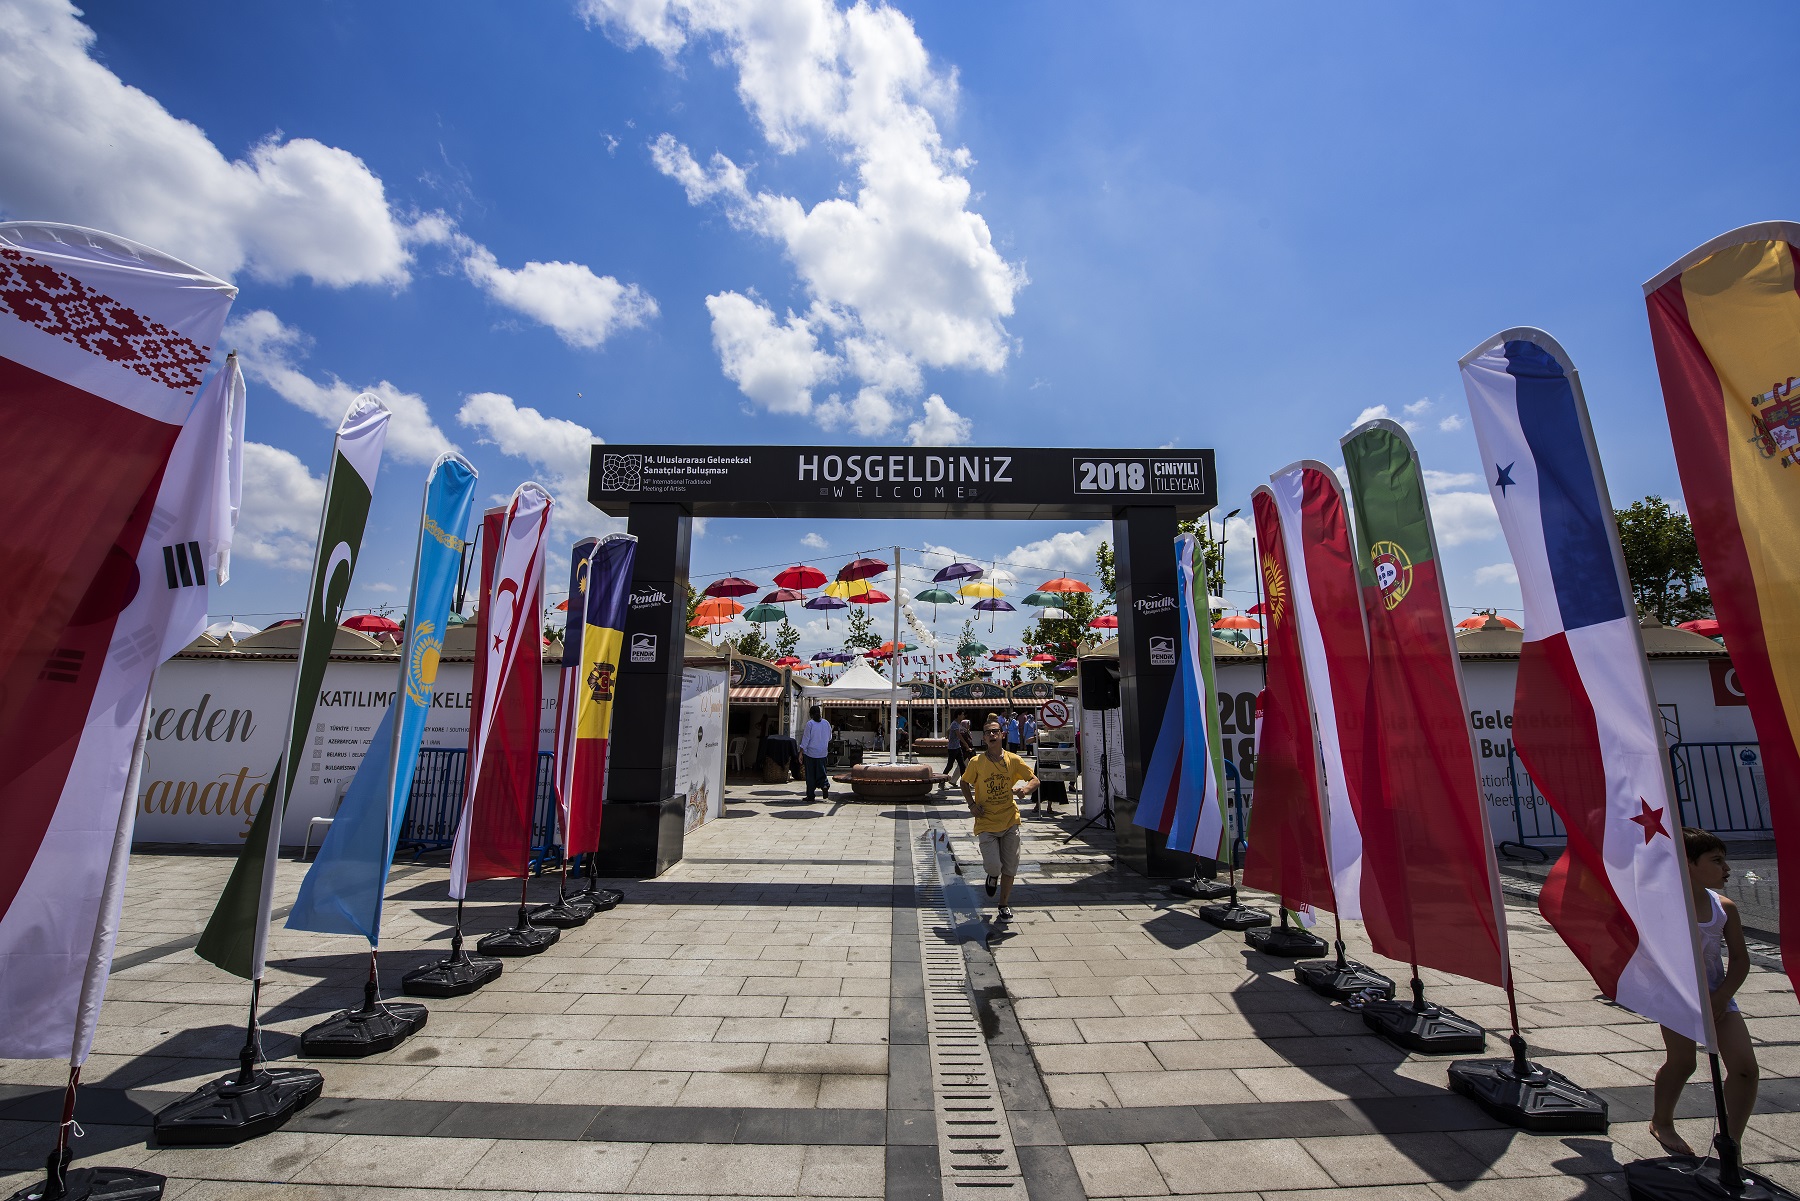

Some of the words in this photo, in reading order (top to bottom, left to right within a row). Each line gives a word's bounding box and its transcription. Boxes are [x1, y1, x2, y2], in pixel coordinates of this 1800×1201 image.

[644, 456, 655, 464] 14.
[657, 456, 706, 464] Uluslararası
[707, 456, 752, 464] Geleneksel
[644, 466, 685, 475] Sanatçılar
[686, 466, 728, 476] Buluşması
[1080, 462, 1145, 490] 2018
[1155, 478, 1200, 491] TILEYEAR
[833, 486, 964, 498] WELCOME
[628, 591, 672, 605] Pendik
[1133, 596, 1179, 610] Pendik
[428, 692, 472, 708] KELE
[1218, 691, 1256, 734] 20
